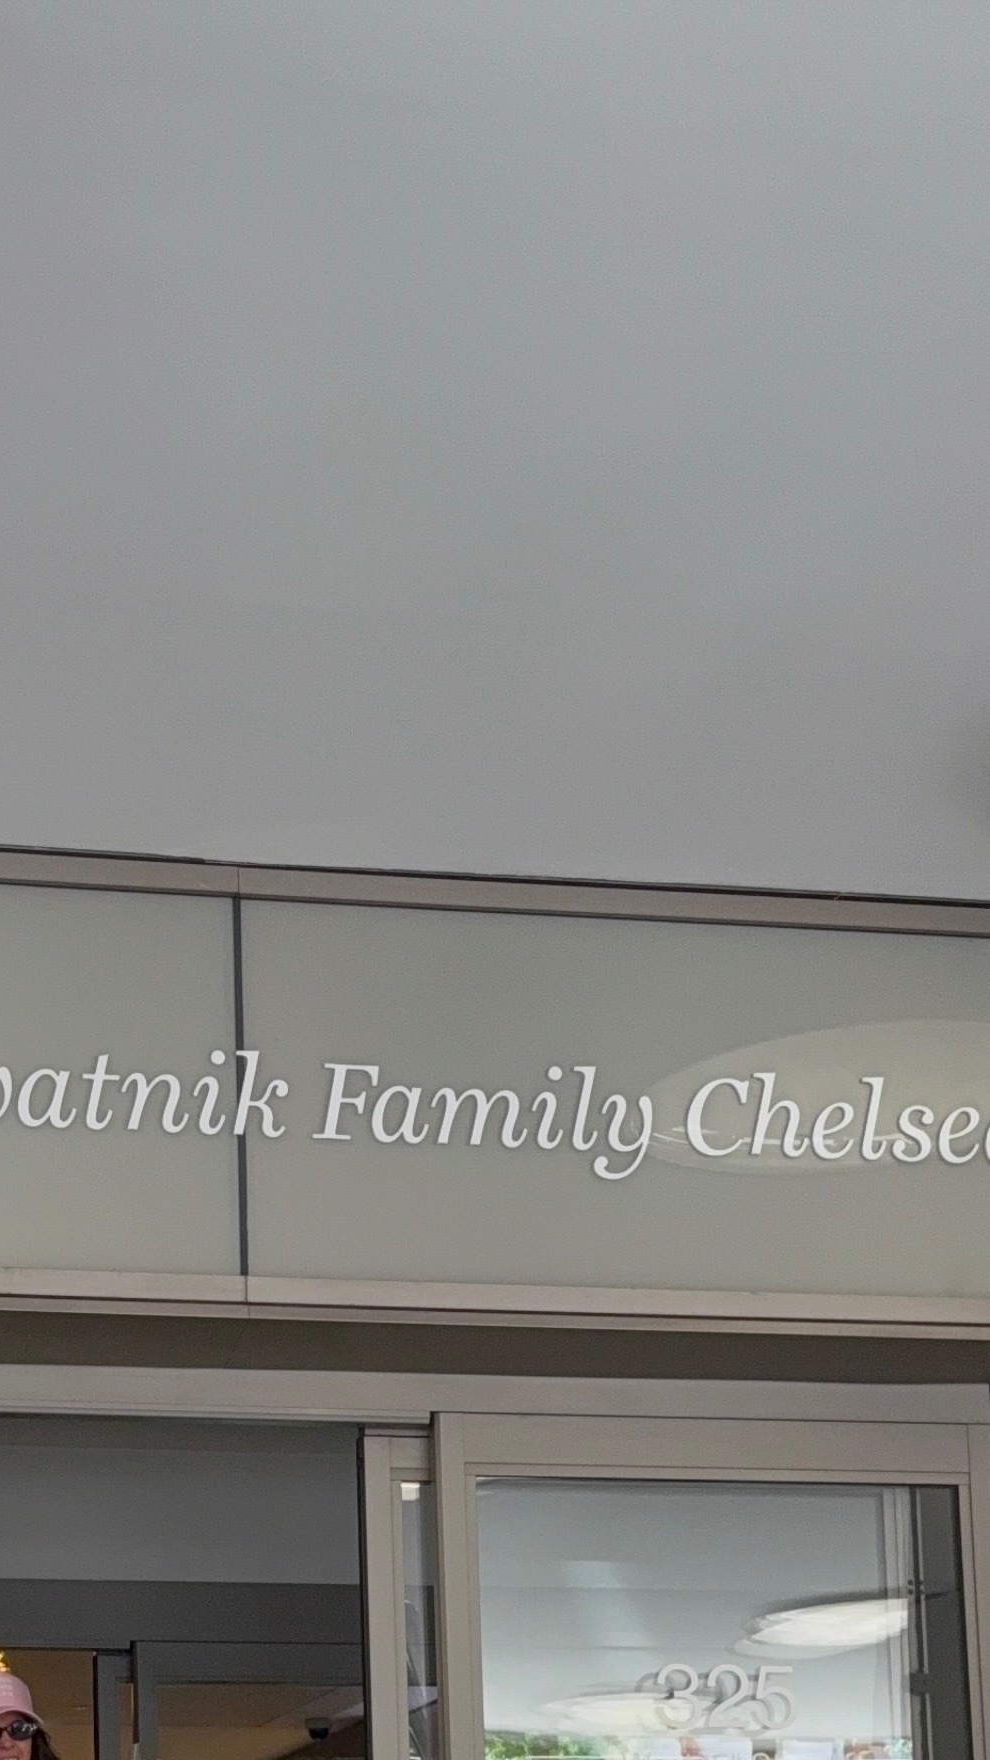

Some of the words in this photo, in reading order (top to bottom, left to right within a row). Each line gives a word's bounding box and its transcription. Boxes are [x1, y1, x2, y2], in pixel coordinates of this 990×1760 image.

[312, 1062, 652, 1180] Family
[686, 1072, 990, 1165] Chelse
[655, 1663, 796, 1731] 325
